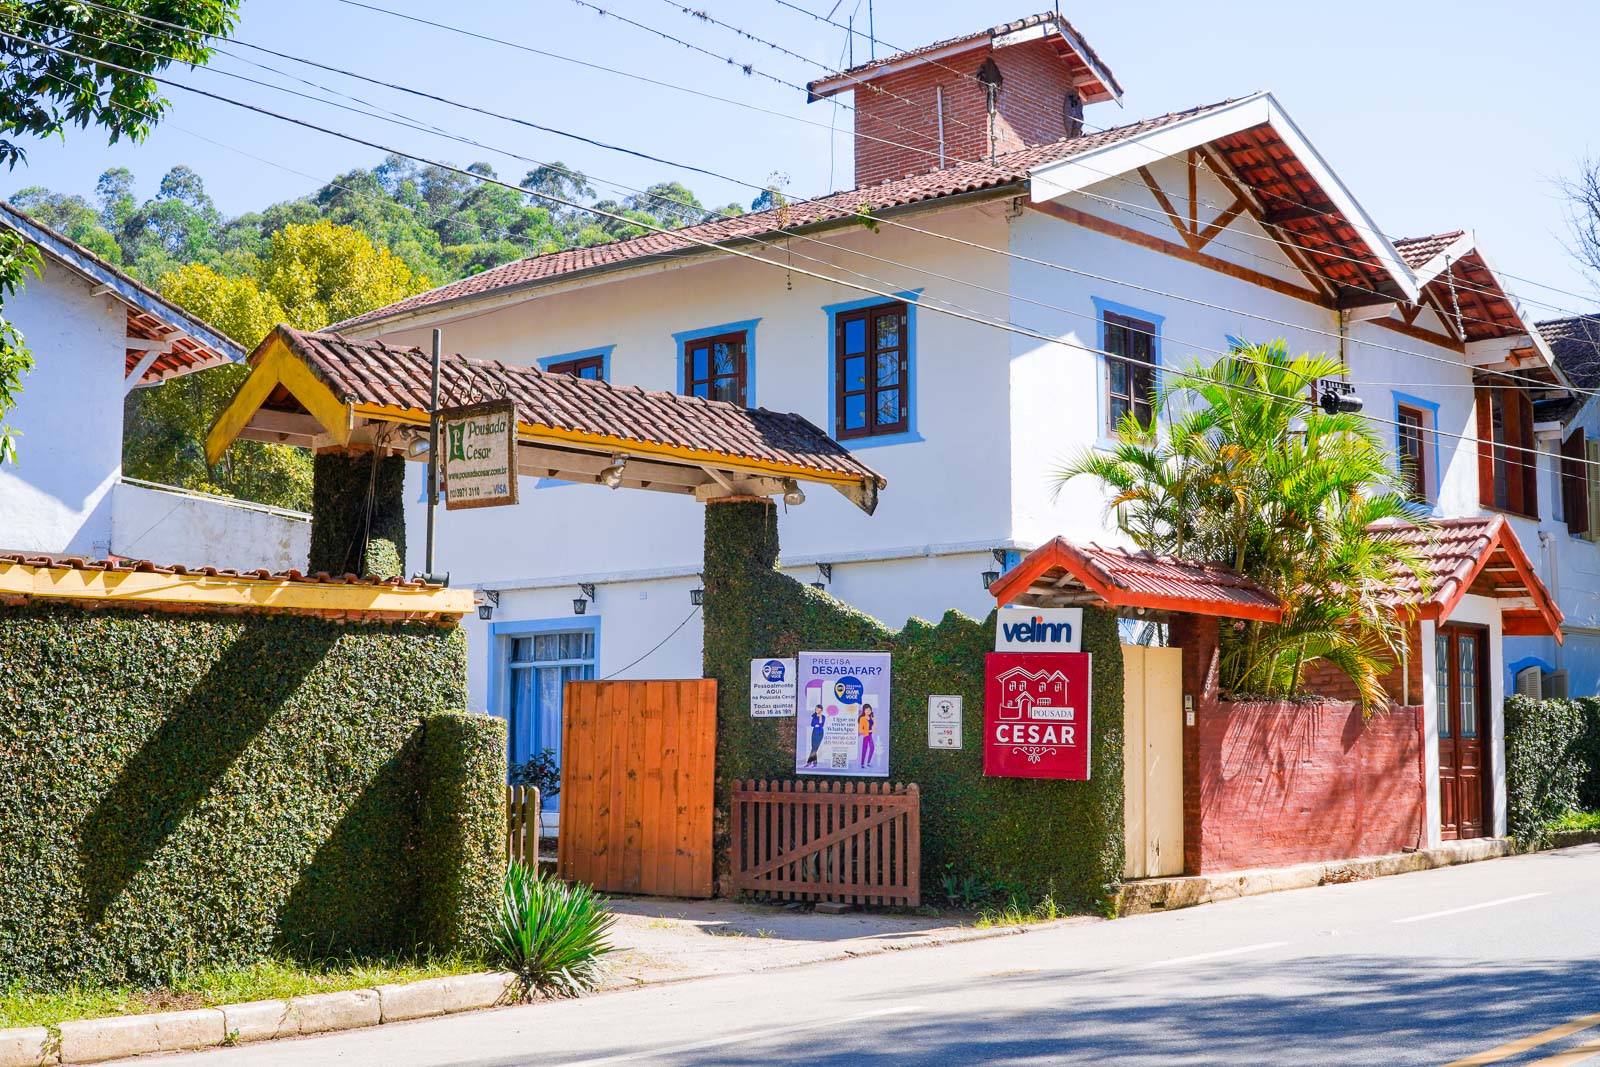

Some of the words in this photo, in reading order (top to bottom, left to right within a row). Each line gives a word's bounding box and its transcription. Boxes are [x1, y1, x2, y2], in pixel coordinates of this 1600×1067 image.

[468, 418, 506, 438] Pousada
[466, 445, 492, 460] Cesar
[493, 483, 507, 495] VISA
[1002, 615, 1072, 644] velinn
[812, 666, 882, 675] DESABAFAR?
[1033, 708, 1073, 718] POUSADA
[995, 724, 1075, 744] CESAR
